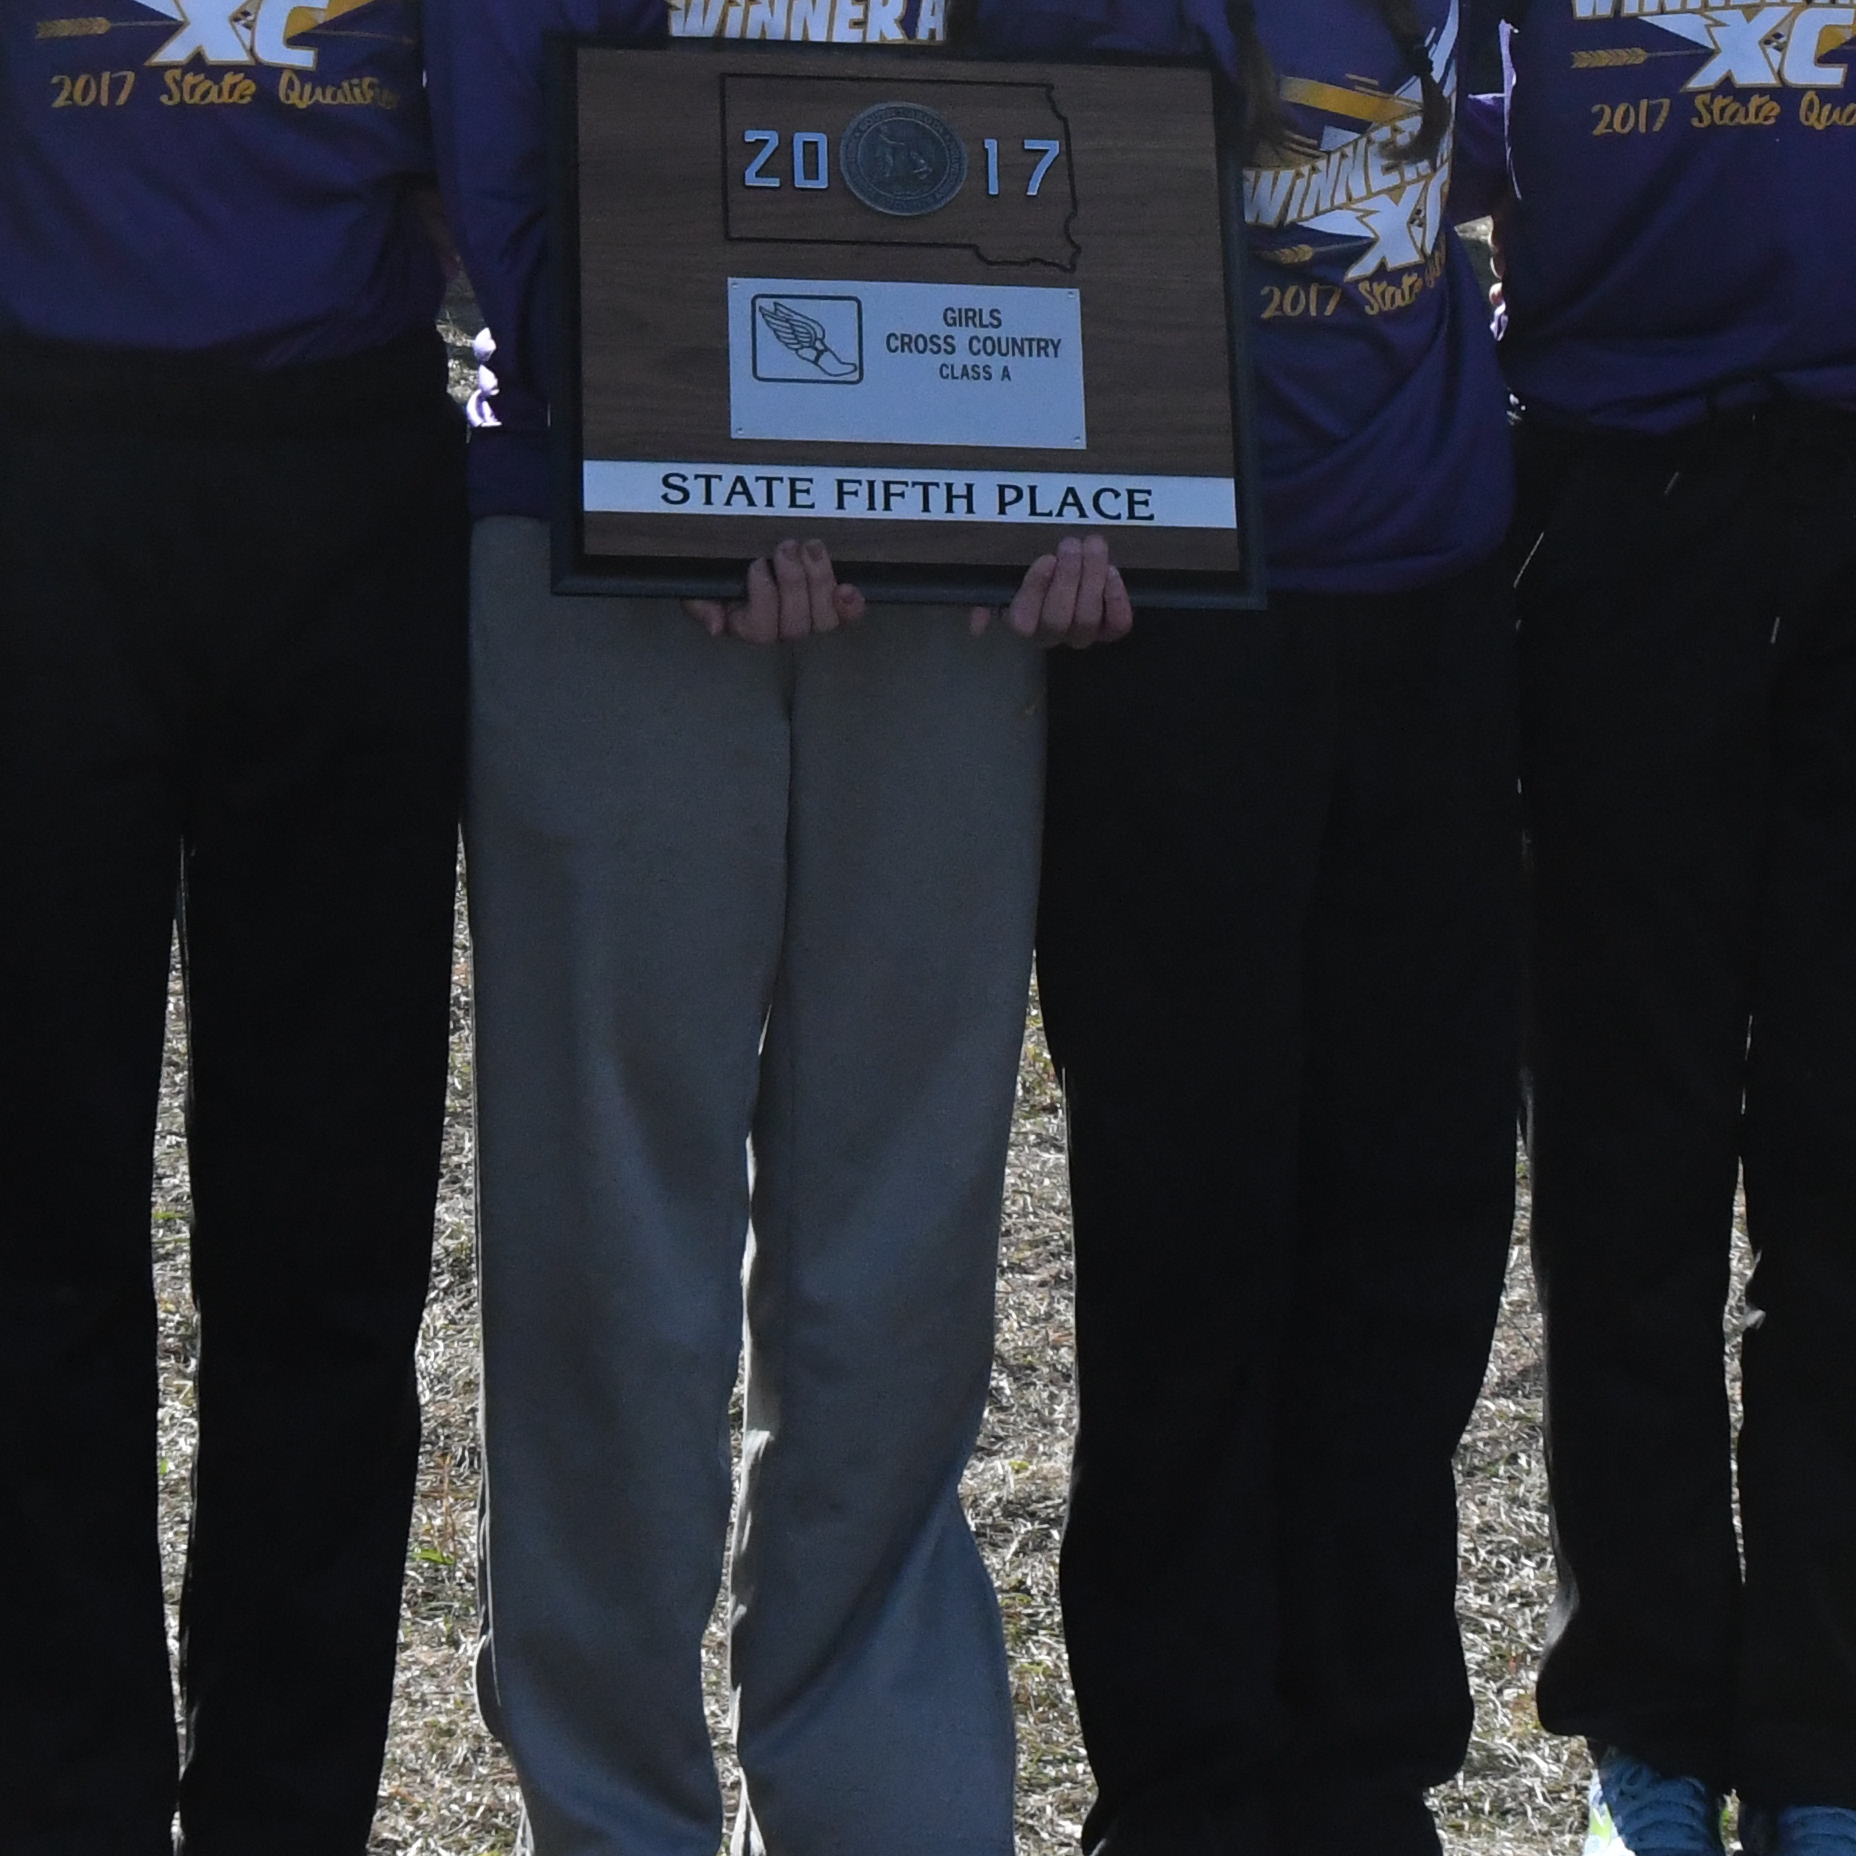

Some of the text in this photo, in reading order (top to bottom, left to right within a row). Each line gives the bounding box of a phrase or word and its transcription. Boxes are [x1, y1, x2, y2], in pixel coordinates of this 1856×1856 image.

[1679, 7, 1856, 93] XC
[51, 71, 135, 108] 2017
[160, 69, 256, 105] State
[1592, 98, 1671, 137] 2017
[1691, 93, 1781, 129] State
[743, 129, 829, 190] 20
[983, 138, 1061, 197] 17
[942, 307, 1002, 330] GIRLS
[1260, 282, 1342, 320] 2017
[885, 332, 1062, 359] CROSS COUNTRY
[939, 363, 1012, 382] CLASS A
[660, 472, 1156, 521] STATE FIFTH PLACE
